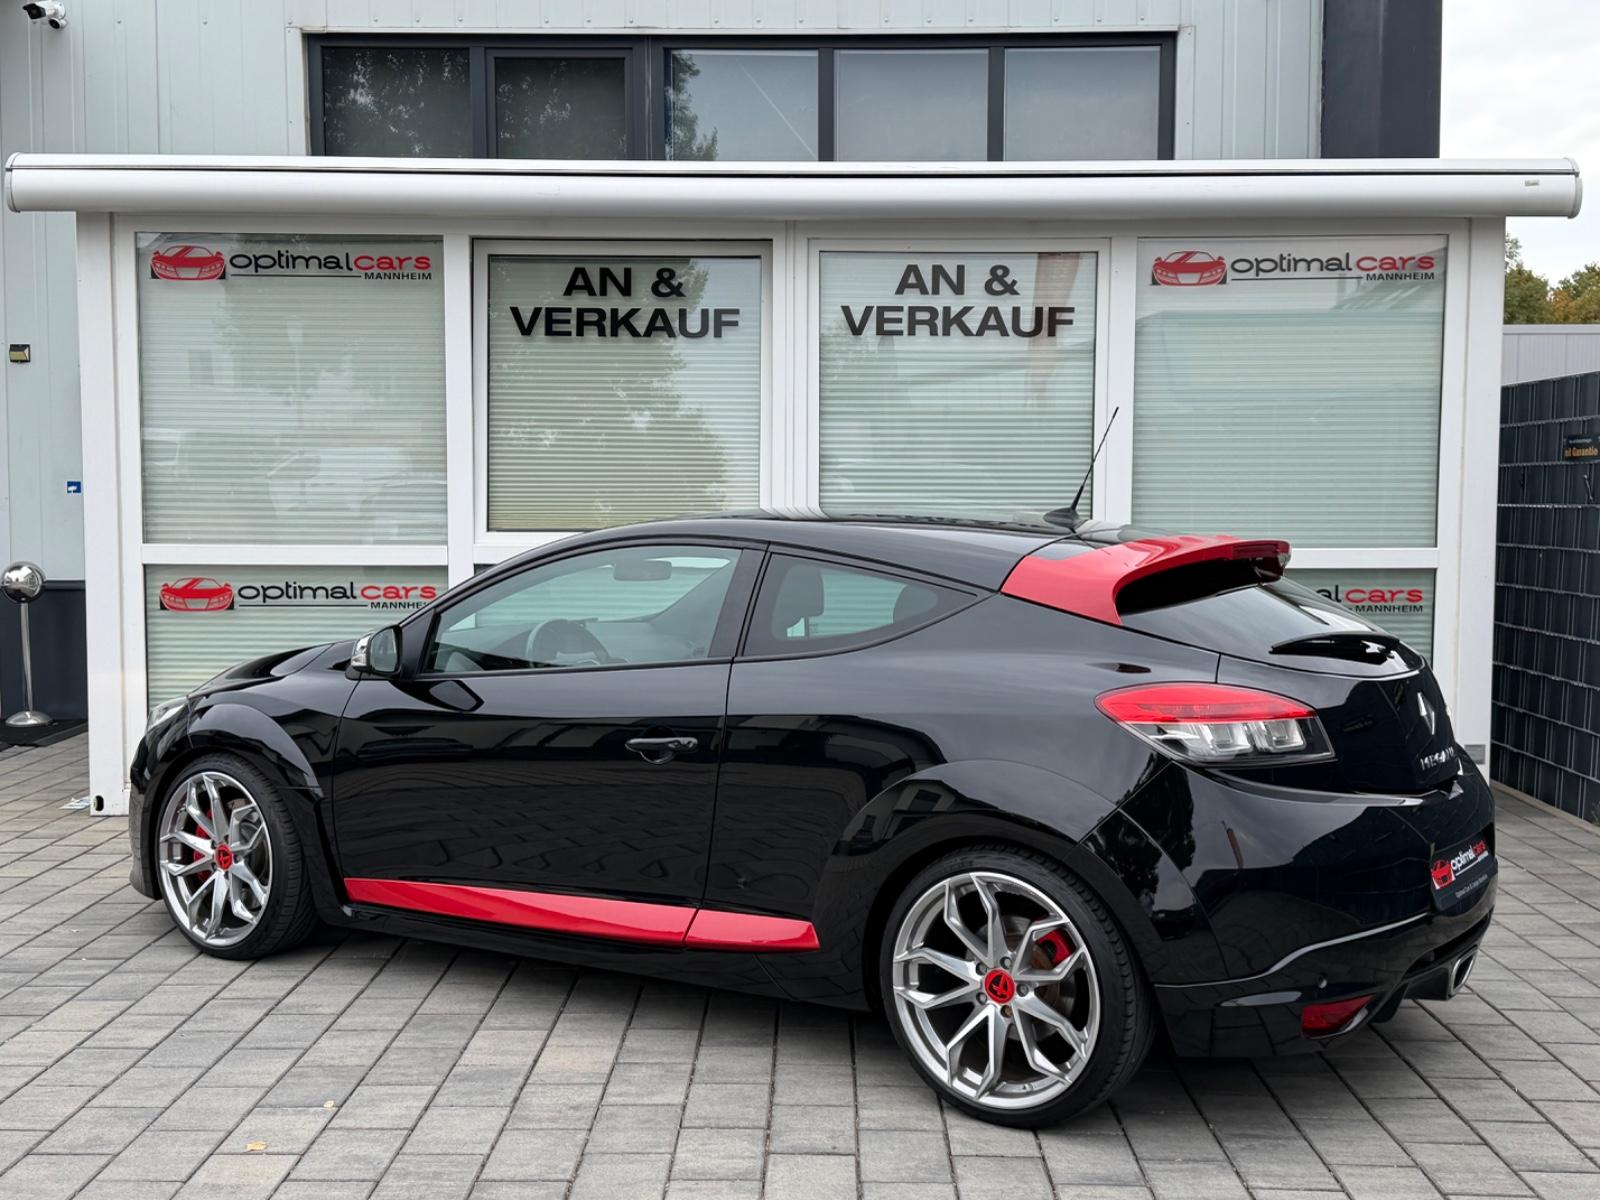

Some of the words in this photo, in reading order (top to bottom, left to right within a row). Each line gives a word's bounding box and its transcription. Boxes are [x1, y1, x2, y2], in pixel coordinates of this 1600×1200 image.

[364, 272, 432, 281] MANNHEIM
[563, 267, 632, 297] AN
[651, 267, 686, 298] &
[894, 264, 966, 296] AN
[984, 264, 1020, 296] &
[1365, 272, 1435, 281] MANNHEIM
[509, 306, 740, 338] VERKAUF
[840, 305, 1075, 338] VERKAUF
[370, 601, 426, 610] MANNHE
[1355, 604, 1424, 613] MANNHEIM
